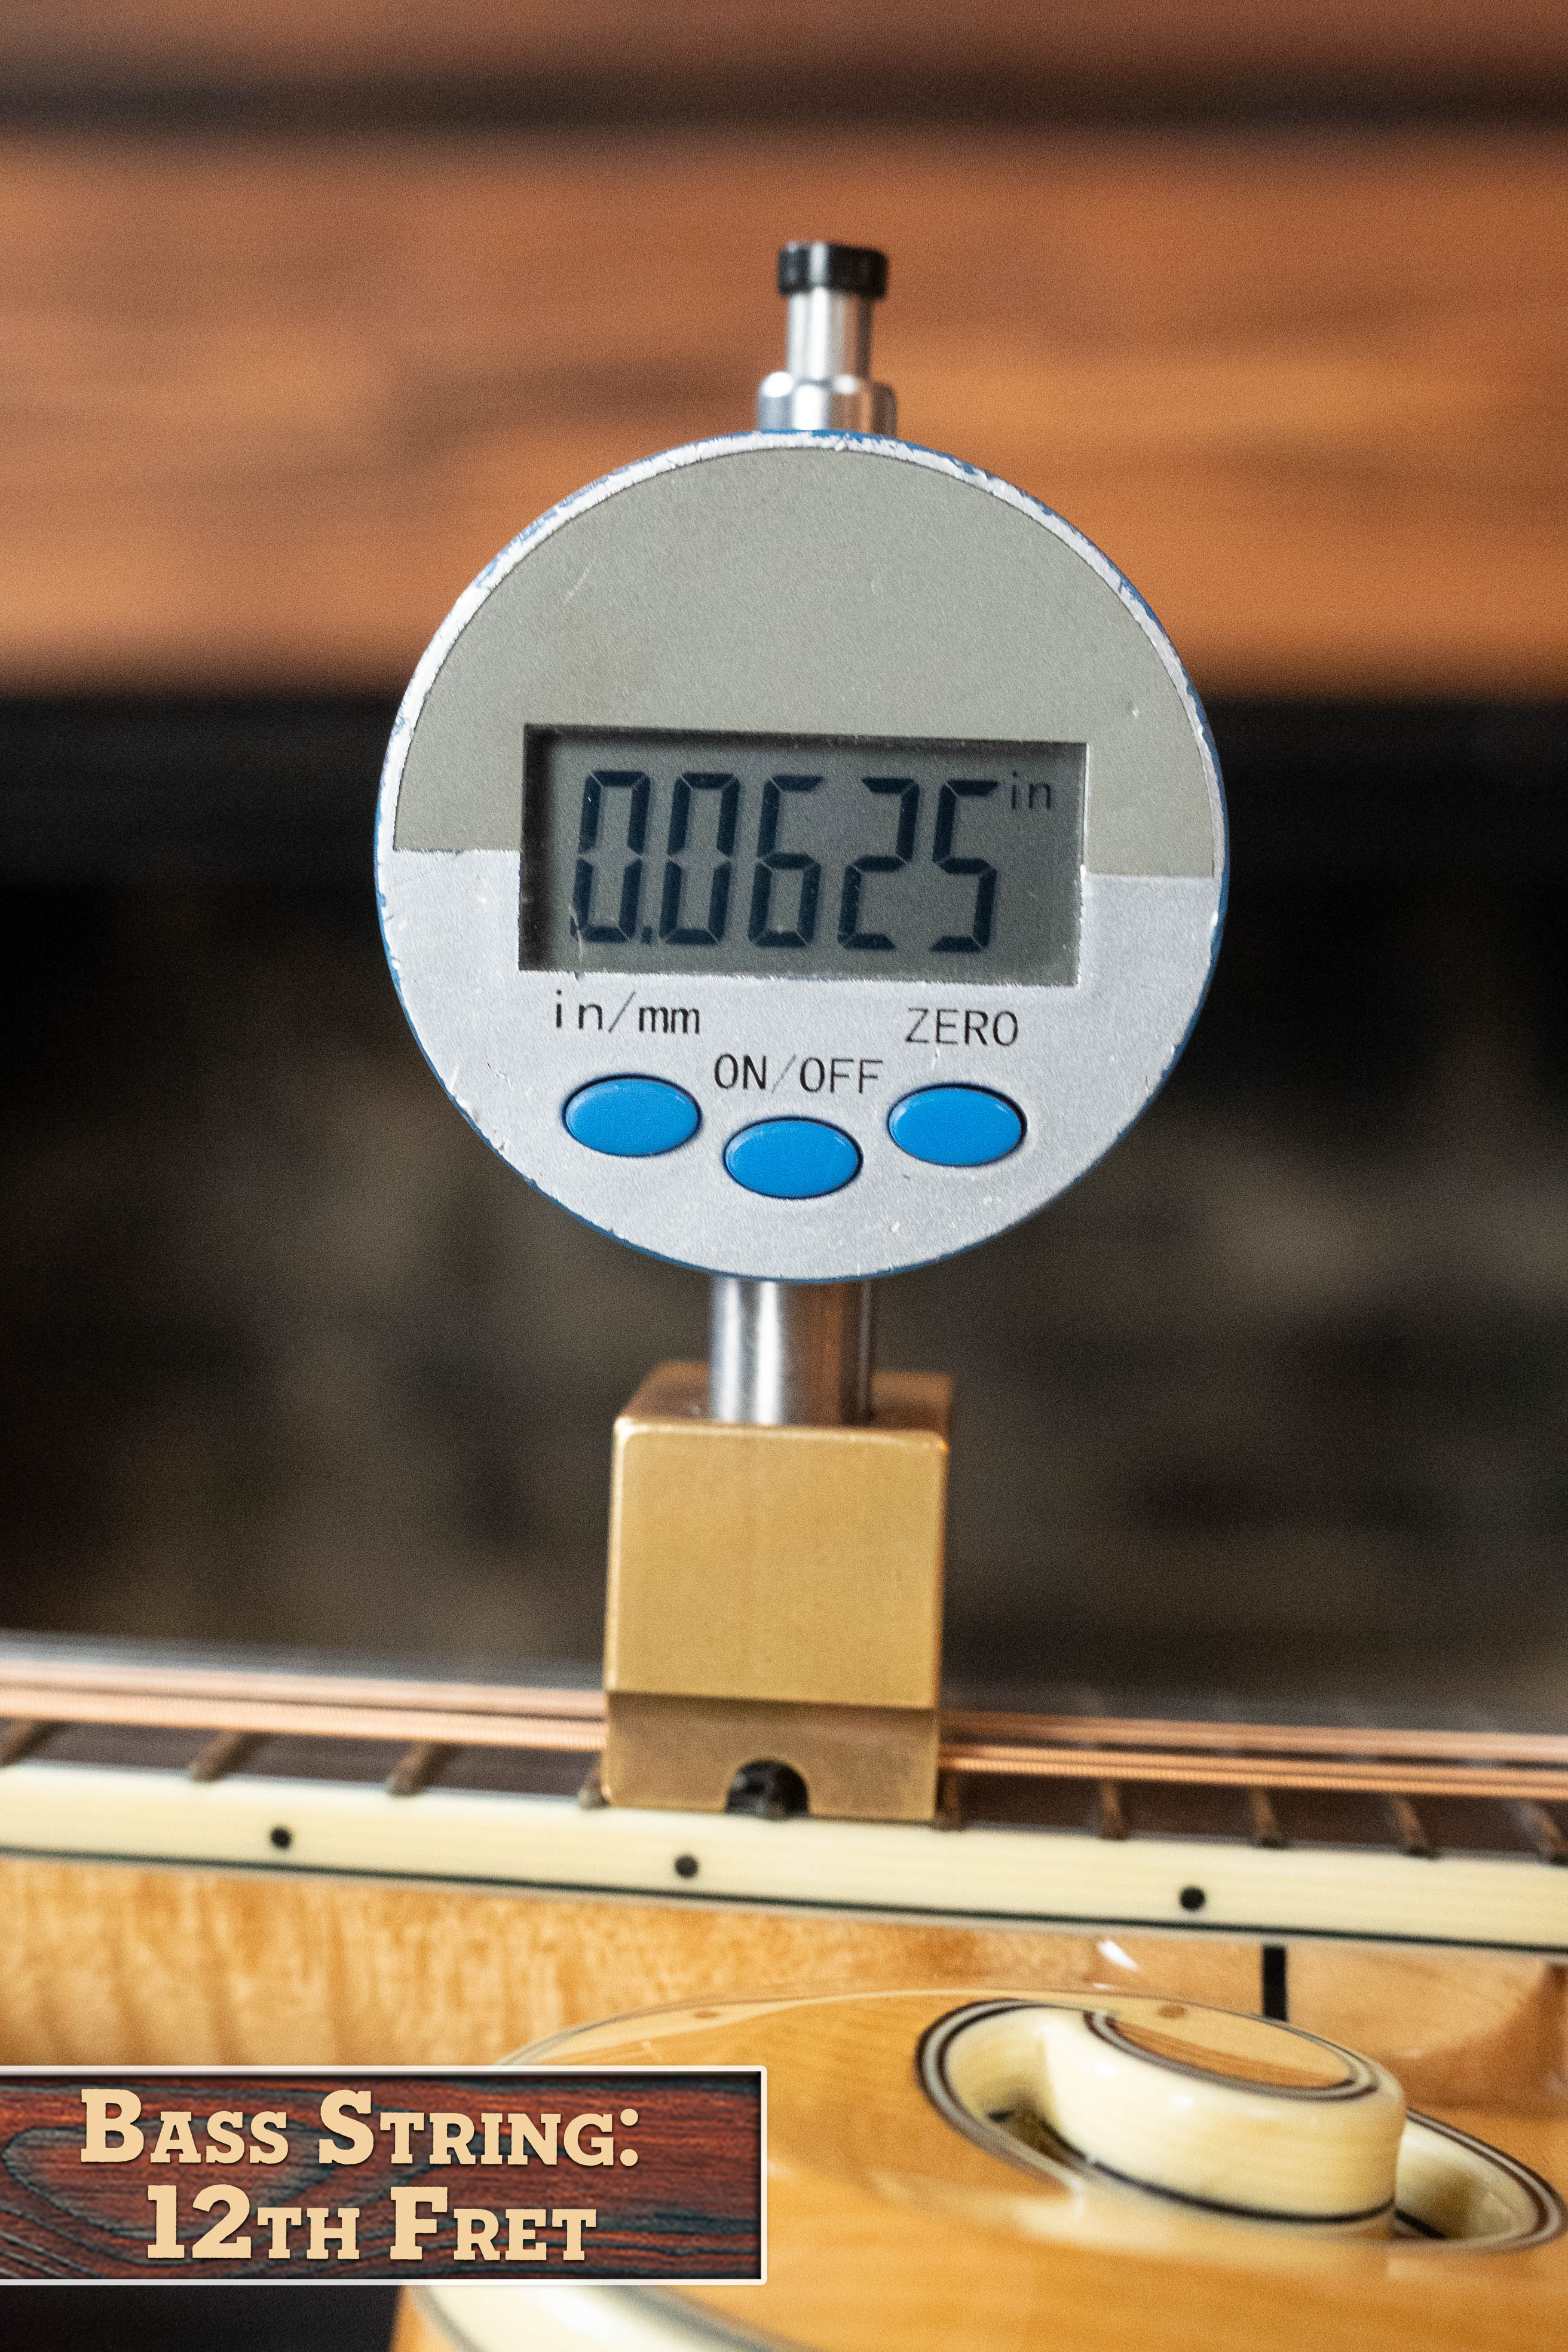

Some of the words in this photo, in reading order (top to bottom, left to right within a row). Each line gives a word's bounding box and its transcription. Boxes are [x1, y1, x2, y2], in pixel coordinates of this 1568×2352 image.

[571, 771, 1000, 953] 0.0625
[1010, 770, 1052, 810] in
[555, 990, 701, 1034] in/mm
[905, 1007, 1019, 1047] ZERO
[713, 1054, 884, 1094] ON/OFF
